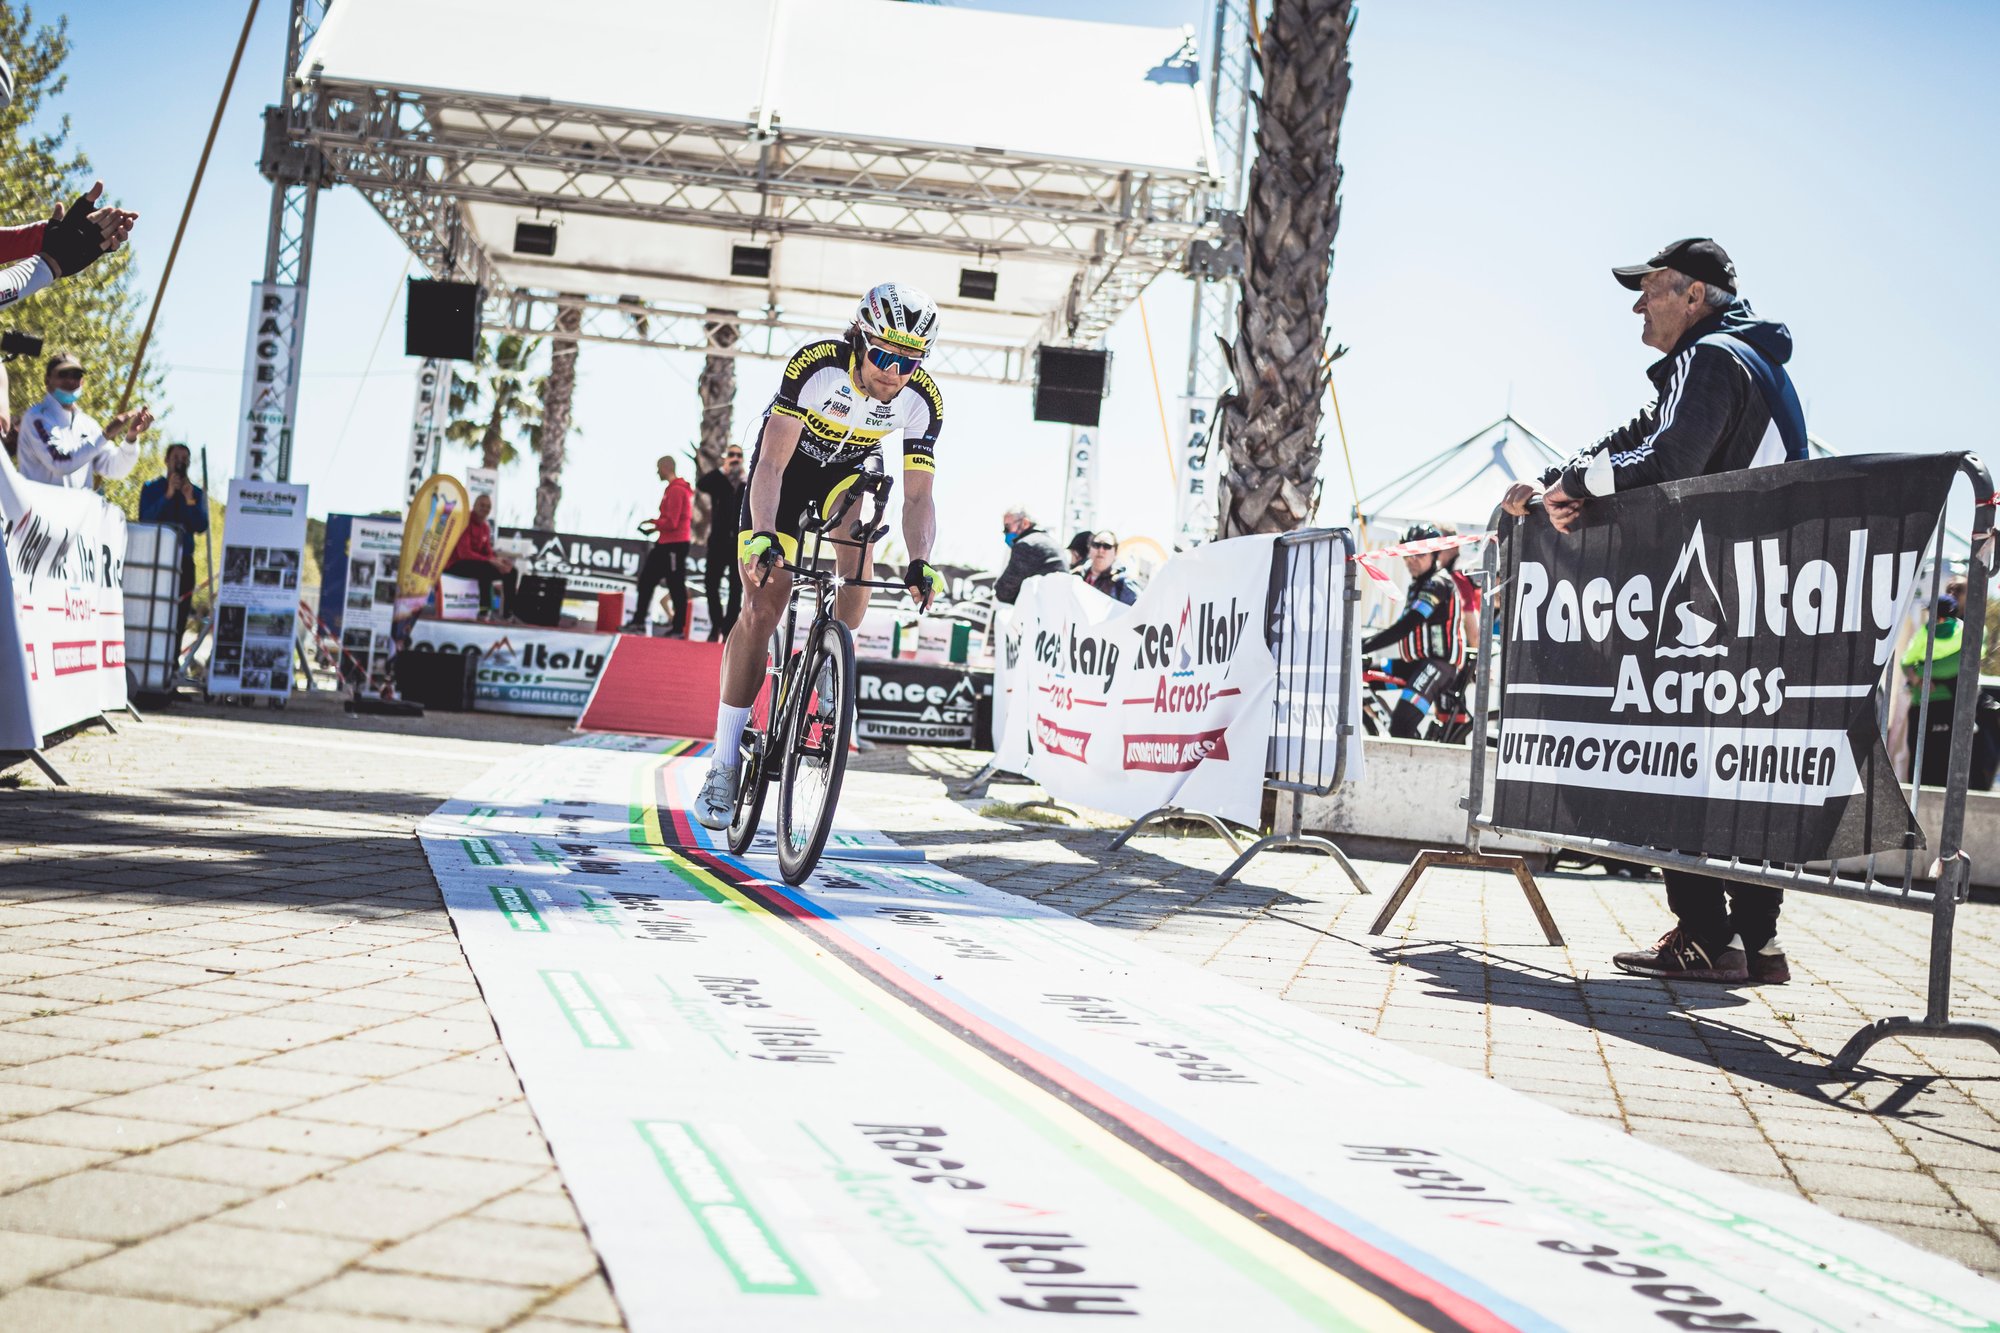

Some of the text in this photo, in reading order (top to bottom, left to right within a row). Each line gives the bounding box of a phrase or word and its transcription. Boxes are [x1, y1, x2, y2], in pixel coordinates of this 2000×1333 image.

[887, 283, 905, 328] FEVER-TREE
[256, 294, 283, 383] RACE
[420, 357, 437, 403] ACE
[785, 343, 837, 380] Wiesbauer
[569, 543, 640, 576] Italy
[1512, 528, 1918, 666] Race Italy
[477, 668, 544, 684] cross
[522, 643, 605, 677] Italy
[859, 675, 948, 705] Race
[1154, 675, 1210, 713] Across
[1610, 655, 1786, 717] Across
[867, 722, 965, 738] ULTRACYCLING
[1502, 732, 1698, 779] ULTRACYCLING
[693, 974, 845, 1064] Race Italy
[1040, 993, 1141, 1025] Italy
[1136, 1042, 1260, 1084] Race
[1343, 1143, 1516, 1205] Italy
[852, 1123, 1140, 1315] Race Italy
